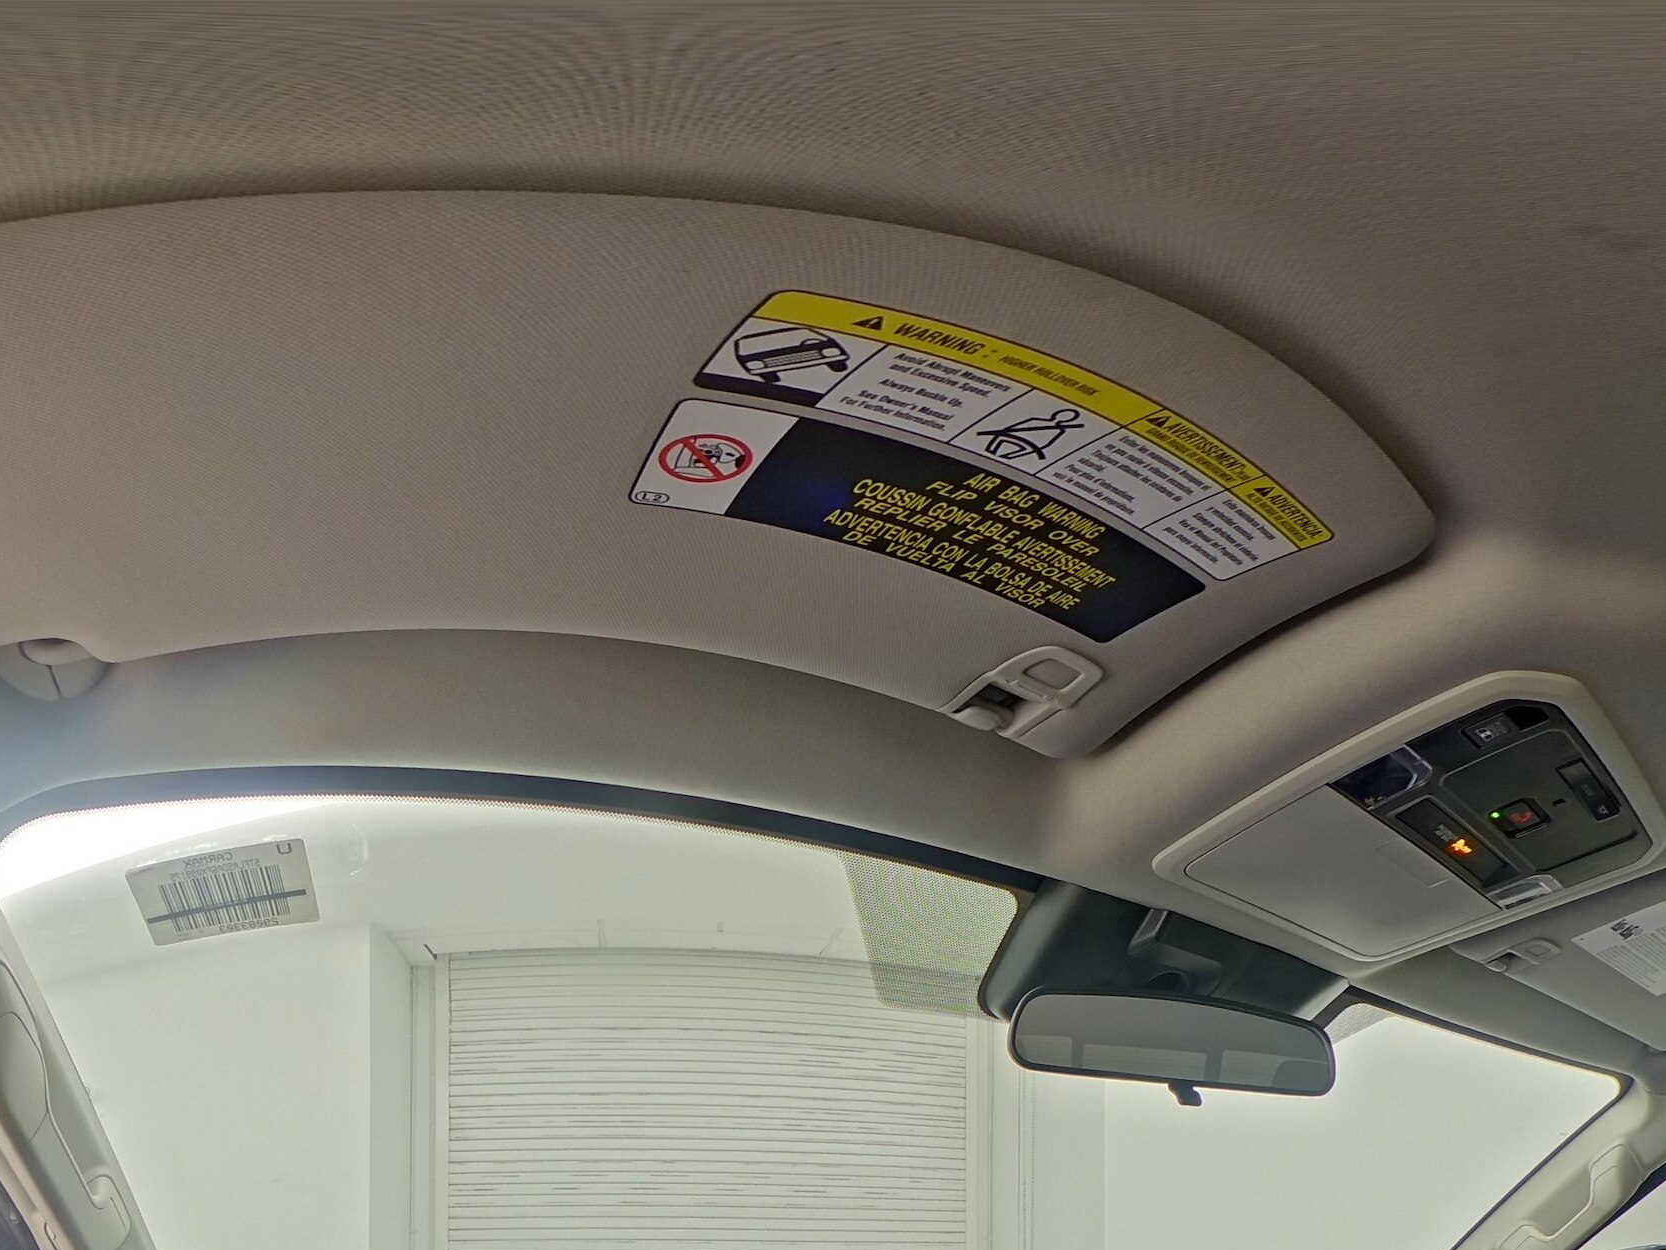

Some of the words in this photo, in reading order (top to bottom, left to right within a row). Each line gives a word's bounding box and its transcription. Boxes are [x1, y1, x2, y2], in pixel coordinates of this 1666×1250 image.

[839, 396, 856, 405] For
[857, 400, 894, 415] Further
[858, 390, 878, 400] See
[879, 394, 916, 411] Owner's
[919, 406, 955, 421] Manual
[878, 378, 914, 394] Always
[915, 388, 948, 402] Buckle
[888, 363, 912, 373] and
[910, 368, 959, 387] Excessive
[958, 382, 992, 398] Speed.
[894, 353, 924, 366] Avoid
[927, 359, 961, 376] Abrupt
[960, 371, 1011, 392] Maneuvers
[853, 479, 932, 511] COUSSIN
[928, 502, 1021, 544] GONFLABLE
[1011, 536, 1117, 588] AVERTISSEMENT
[925, 480, 978, 500] FLIP
[983, 500, 1045, 530] VISOR
[1048, 530, 1100, 556] OVER
[963, 473, 1001, 492] AIR
[998, 485, 1041, 508] BAG
[1037, 501, 1106, 540] WARNING
[822, 508, 934, 551] ADVERTENCIA
[932, 541, 970, 563] CON
[963, 554, 989, 571] LA
[984, 562, 1032, 589] BOLSA
[1027, 581, 1053, 597] DE
[1044, 590, 1082, 610] AIRE
[842, 530, 878, 546] DE
[885, 542, 957, 573] VUELTA
[959, 571, 986, 585] AL
[994, 582, 1046, 609] VISOR
[853, 498, 948, 532] REPLIER
[952, 529, 984, 545] LE
[986, 543, 1087, 593] PARESOLEIL
